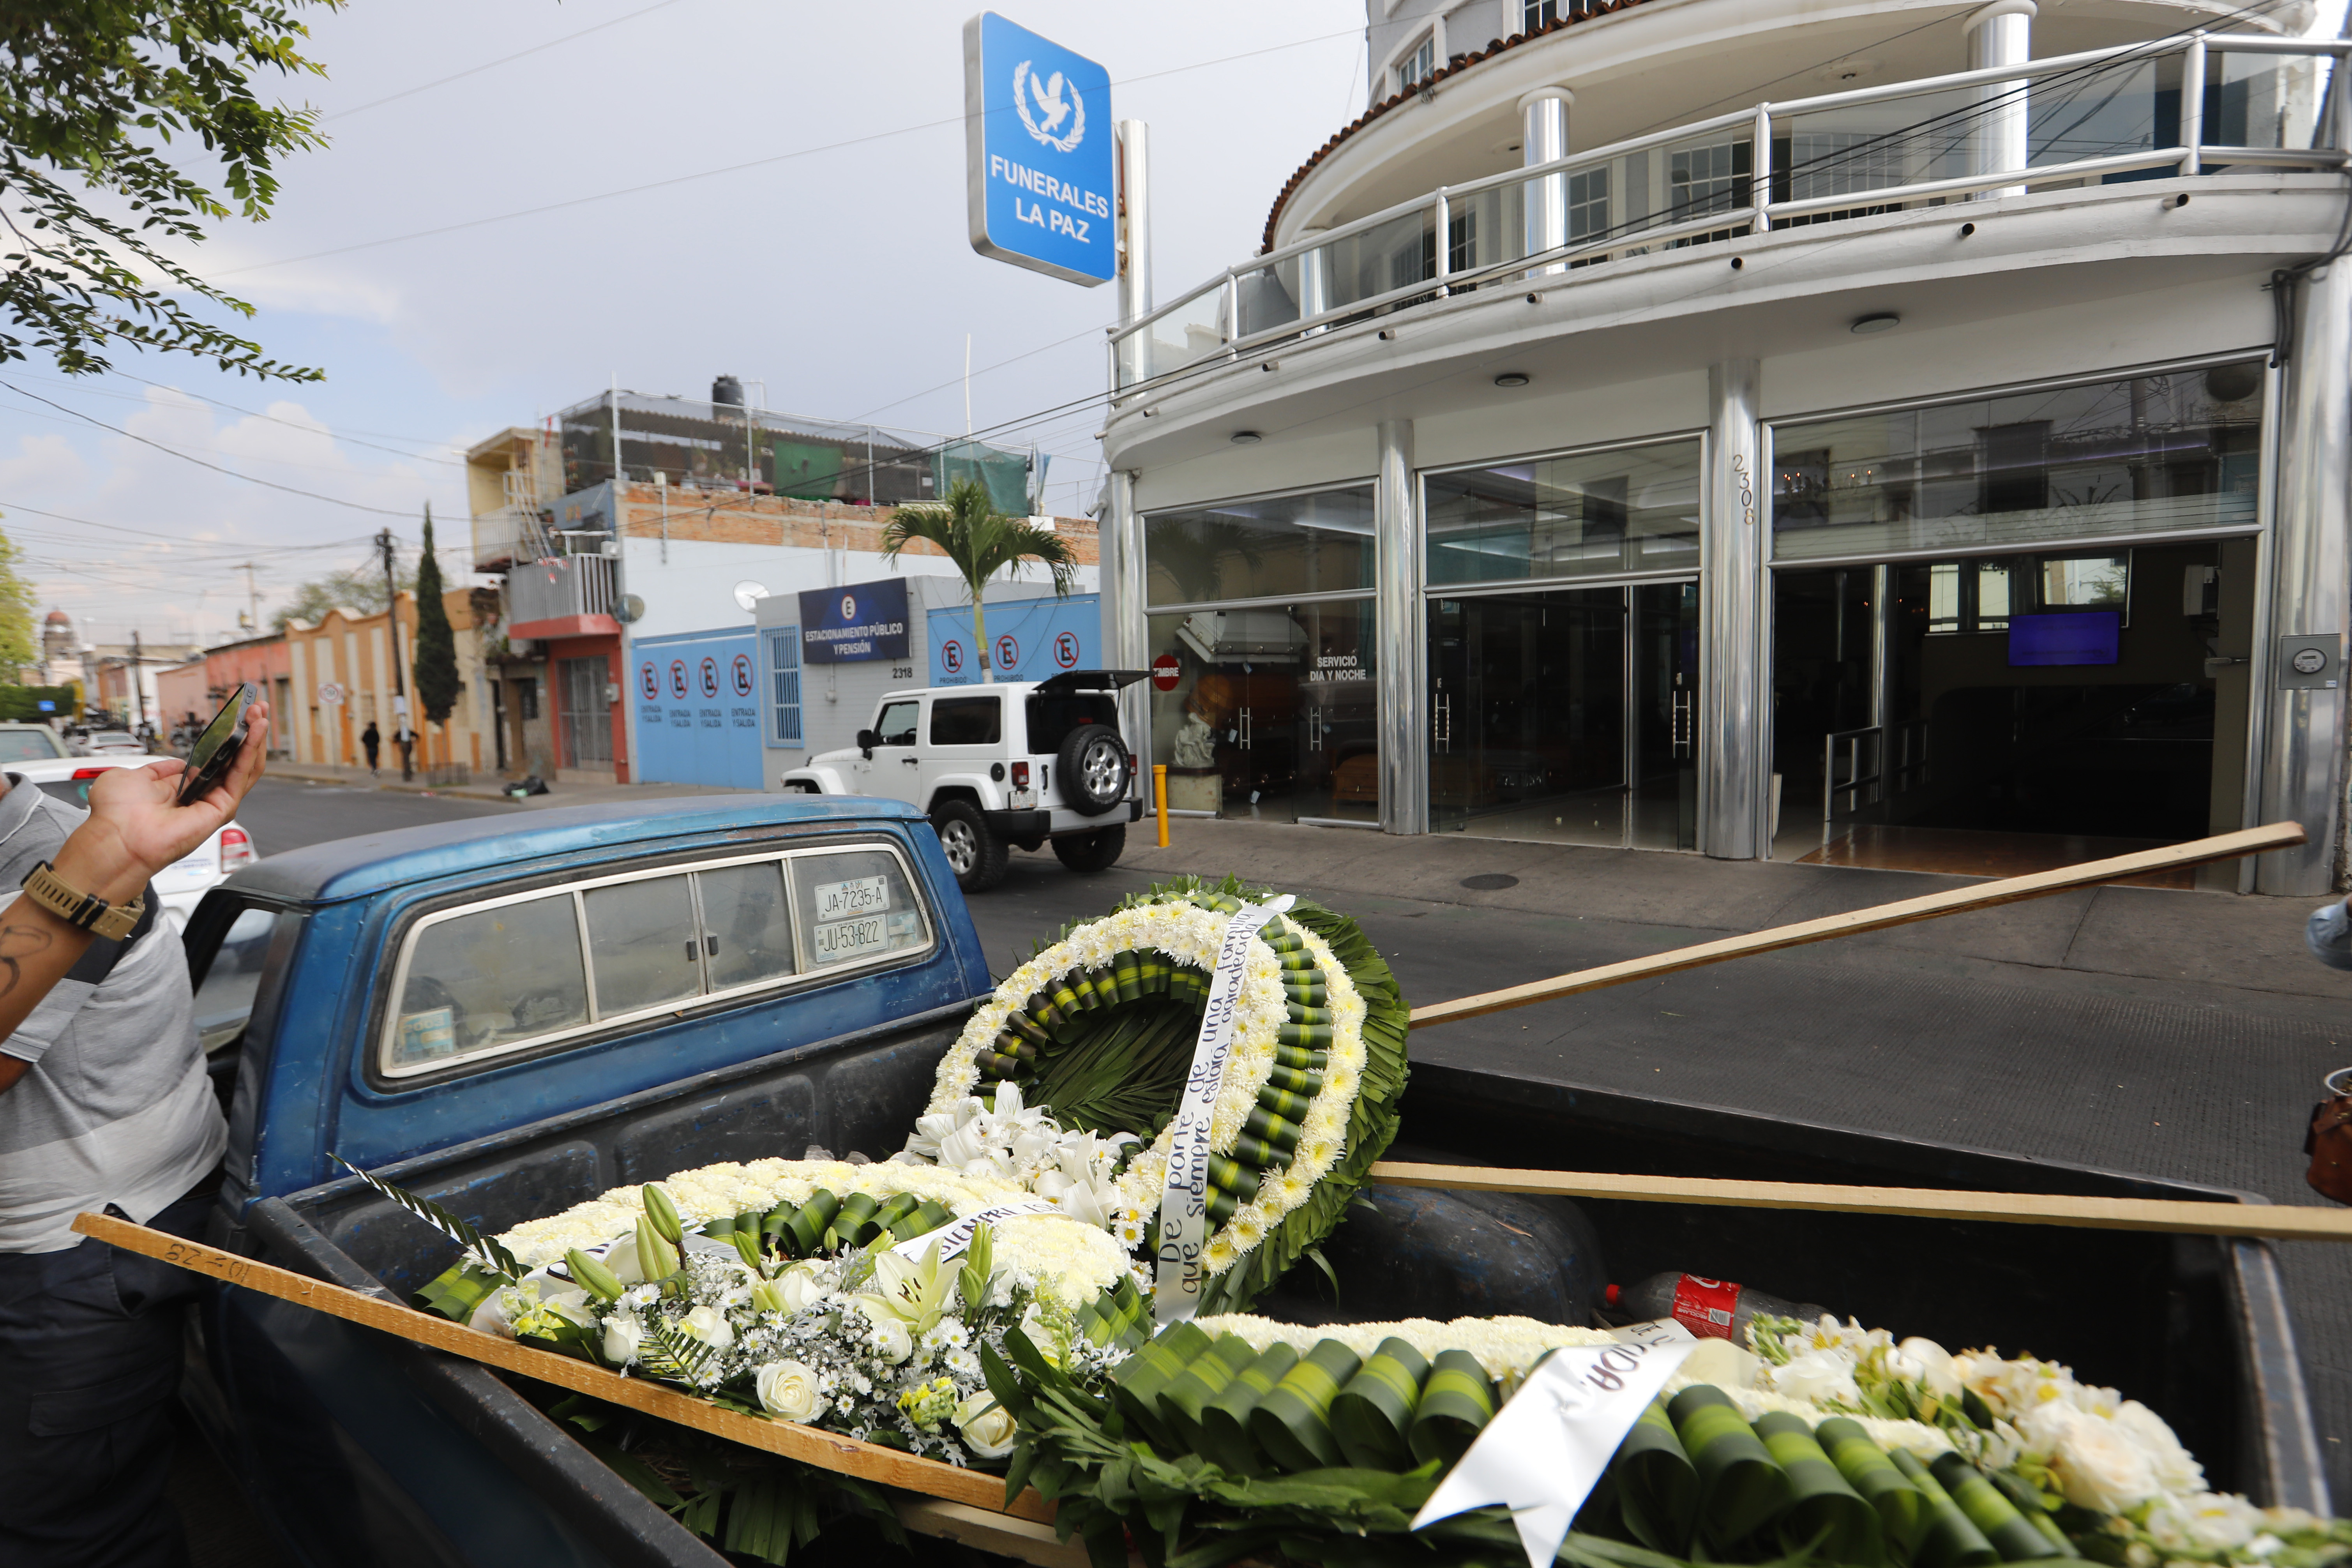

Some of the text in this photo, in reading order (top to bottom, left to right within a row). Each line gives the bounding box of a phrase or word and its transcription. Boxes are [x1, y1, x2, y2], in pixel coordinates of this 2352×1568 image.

[991, 154, 1109, 219] FUNERALES
[1016, 197, 1090, 244] LA PAZ
[1734, 454, 1754, 525] 2308
[805, 622, 903, 642] ESTACIONAMIENTO PÚBLICO
[892, 667, 912, 678] 2318
[1317, 655, 1358, 667] SERVICIO
[994, 673, 1024, 682] PROHIBIDO
[1310, 669, 1366, 681] DIA Y NOCHE
[641, 705, 662, 713] ENTRADA
[669, 709, 691, 718] ENTRADA
[699, 708, 721, 718] ENTRADA
[731, 708, 756, 717] ENTRADA
[825, 886, 883, 912] JA-7235-A
[824, 920, 879, 952] JU-53-822
[1202, 1042, 1229, 1104] estará
[1158, 913, 1255, 1263] De parte de una familia
[1186, 1116, 1211, 1218] siempre
[1182, 1242, 1202, 1294] que
